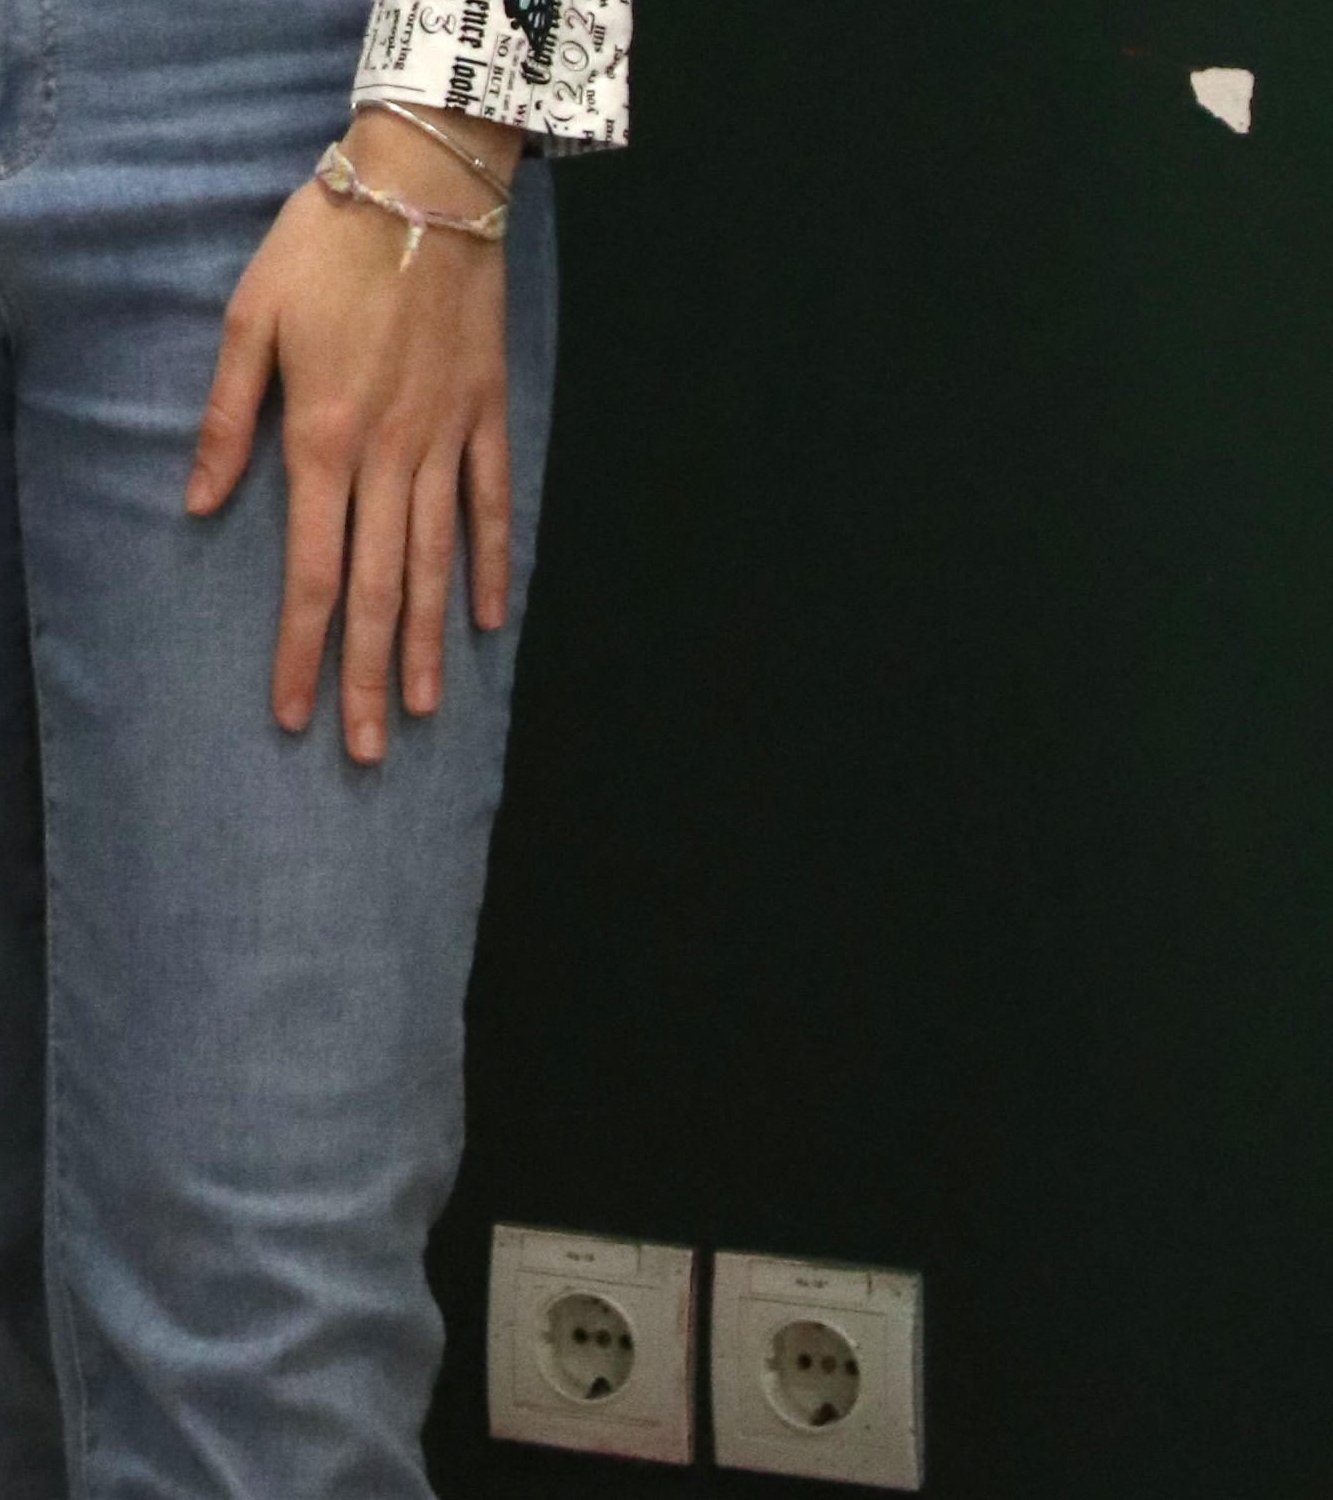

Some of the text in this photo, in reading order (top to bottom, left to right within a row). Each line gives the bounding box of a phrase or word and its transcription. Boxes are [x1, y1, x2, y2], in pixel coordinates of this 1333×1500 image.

[392, 0, 422, 71] worrying
[487, 34, 513, 99] NO BUT
